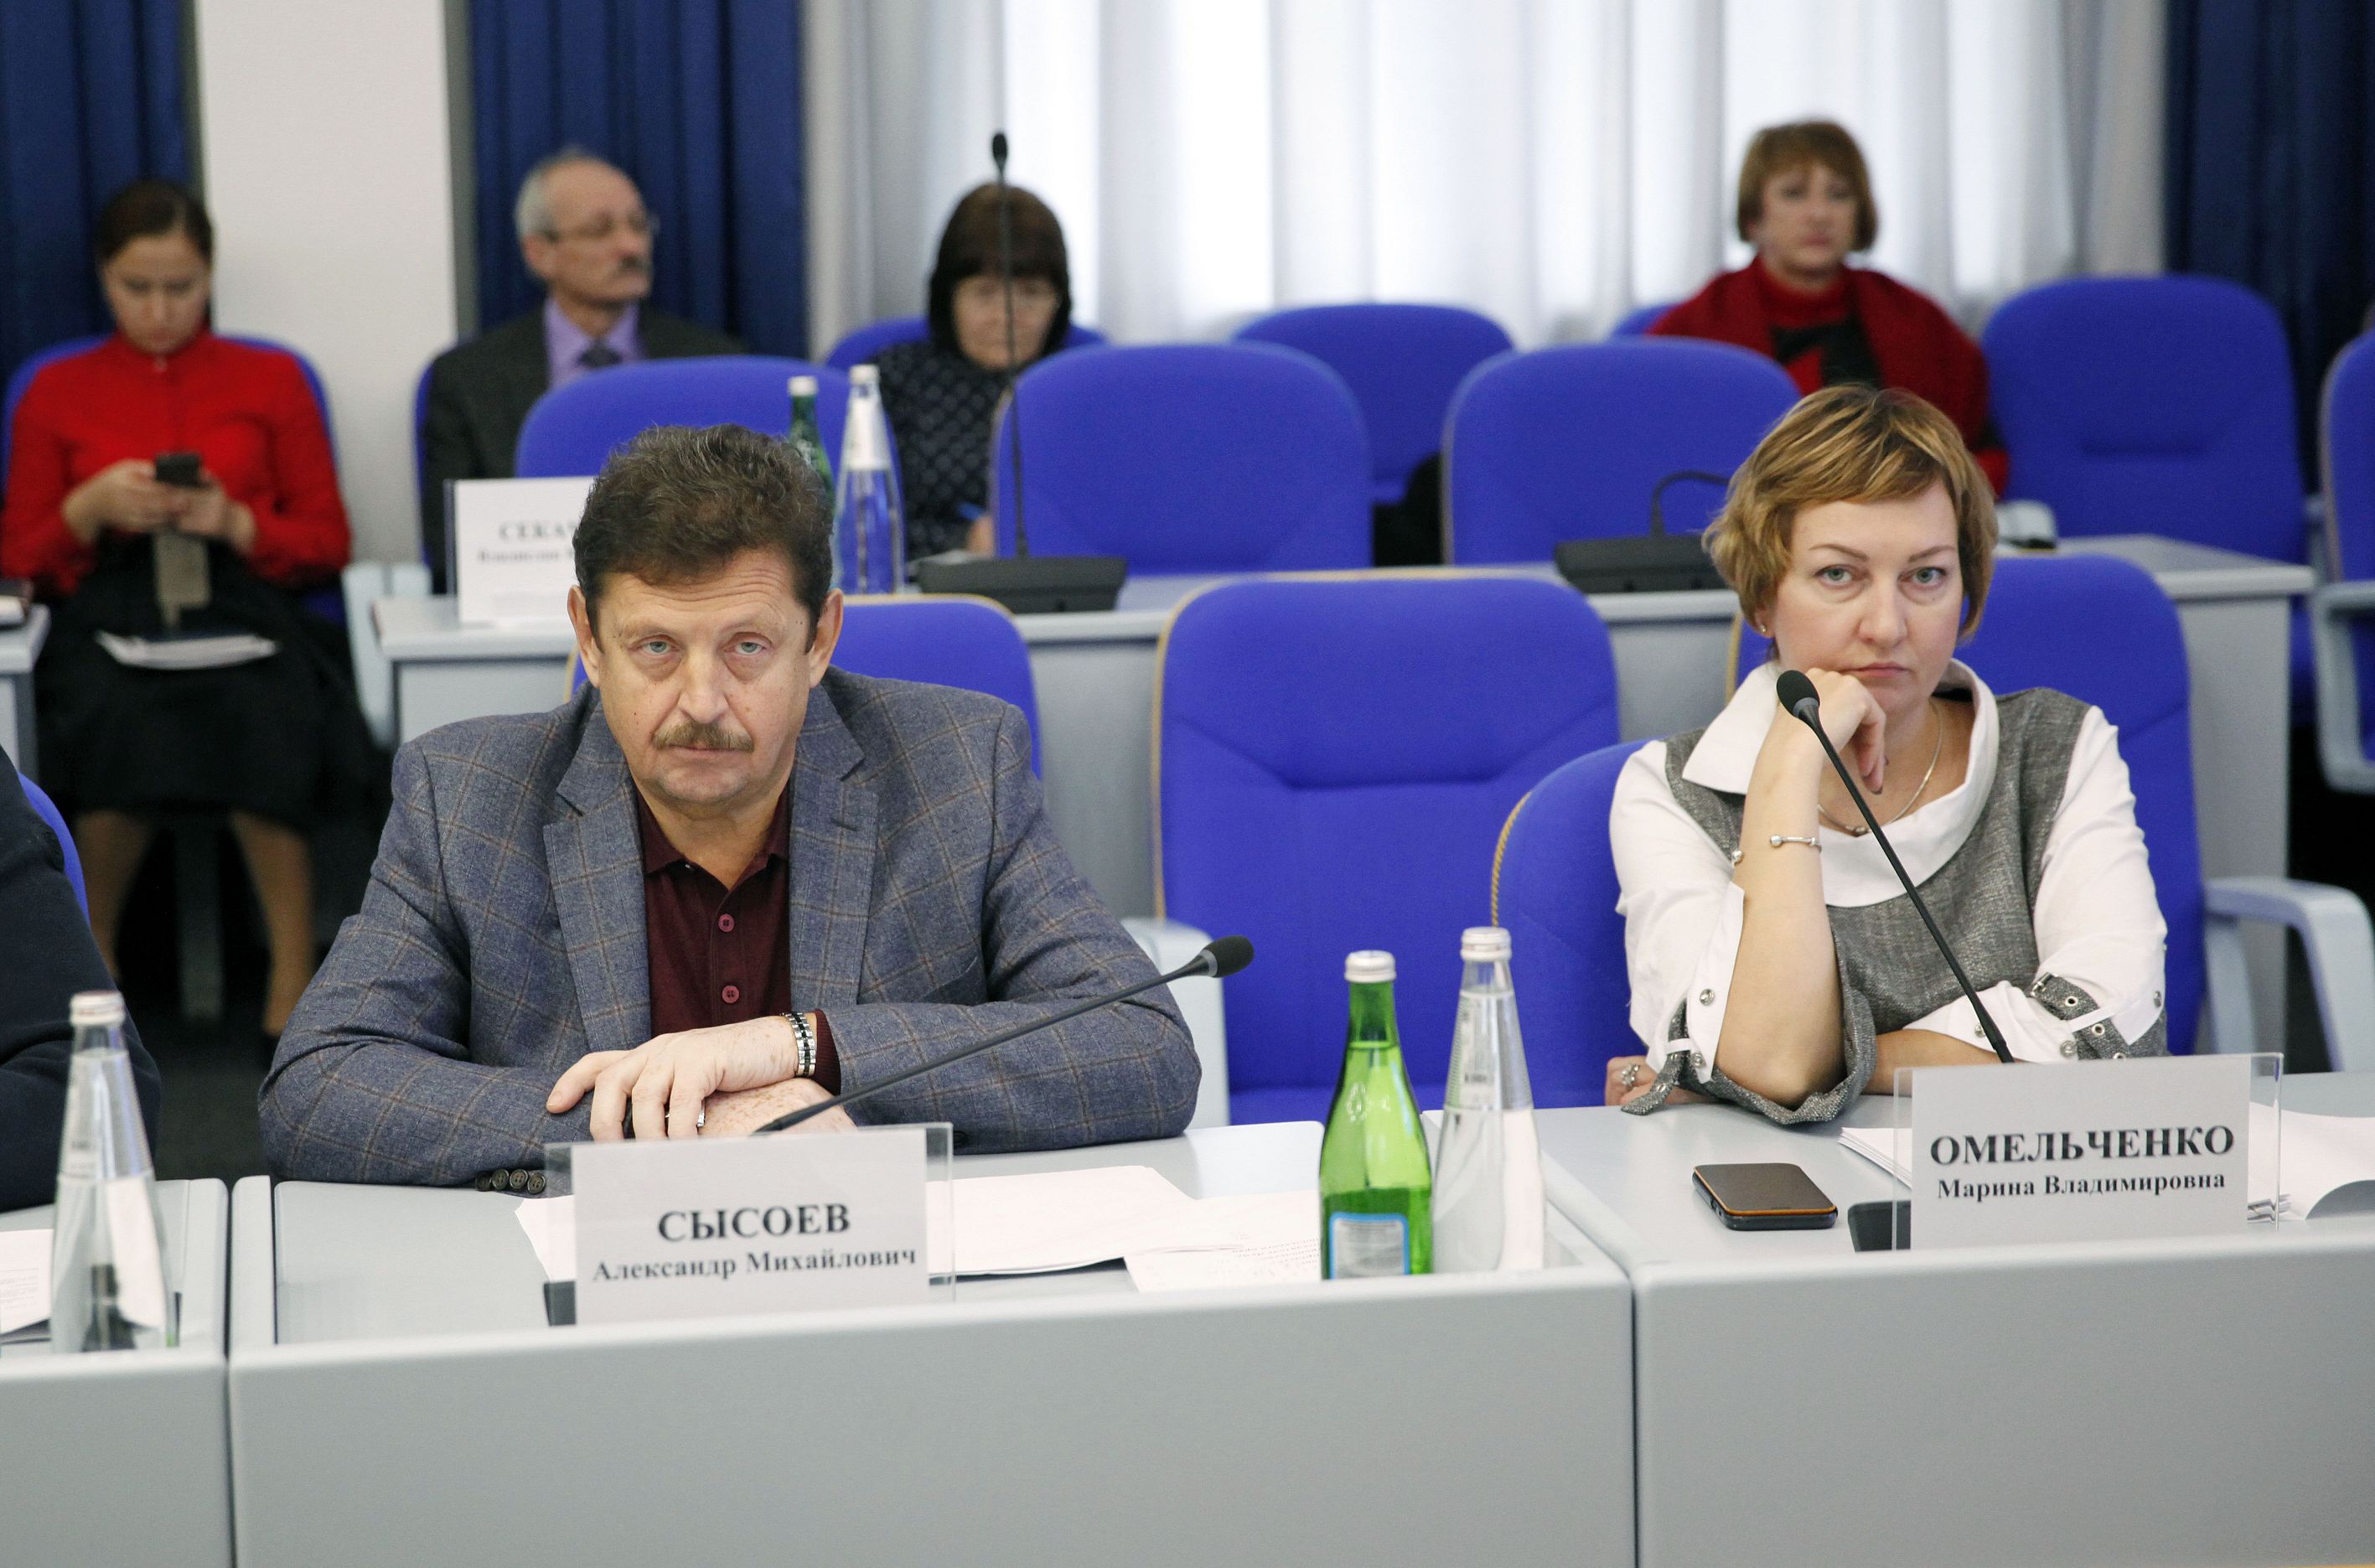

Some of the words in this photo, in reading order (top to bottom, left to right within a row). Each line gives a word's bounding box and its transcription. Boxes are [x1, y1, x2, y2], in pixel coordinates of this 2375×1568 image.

[1930, 1124, 2235, 1166] ОМЕЛЬЧЕНКО
[1938, 1177, 2036, 1203] Марина
[2044, 1173, 2226, 1197] Владимировна
[658, 1203, 851, 1242] СЫСОЕВ
[592, 1260, 737, 1281] Александр
[746, 1249, 916, 1273] Михайлович
